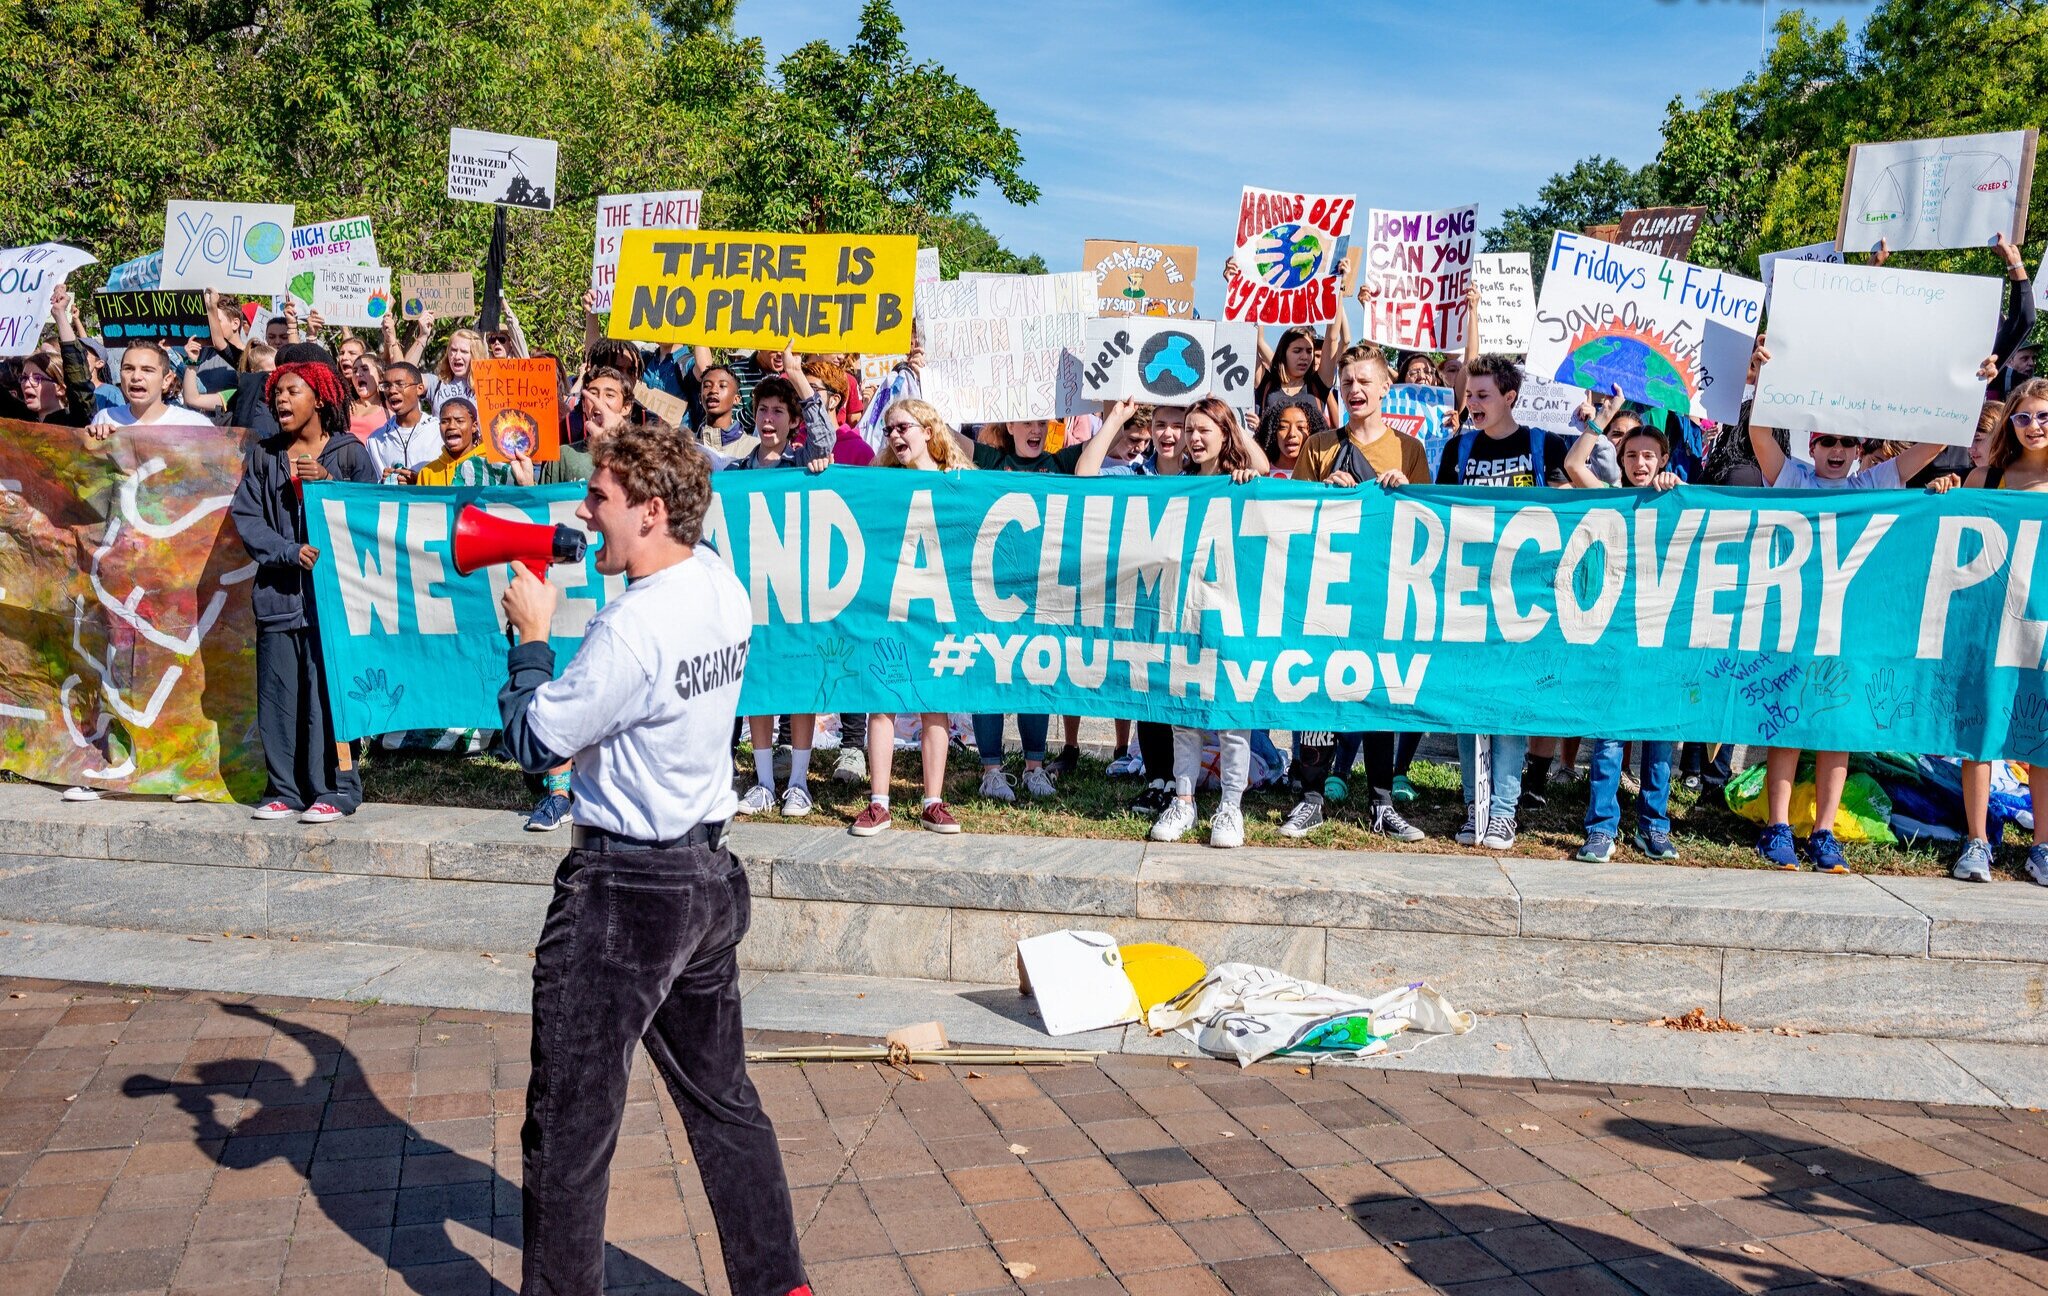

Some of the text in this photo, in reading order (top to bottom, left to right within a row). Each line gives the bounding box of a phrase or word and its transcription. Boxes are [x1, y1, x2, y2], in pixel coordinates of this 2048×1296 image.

[450, 165, 496, 179] CLIMATE
[451, 154, 507, 169] WAR-SIZED
[450, 175, 489, 188] ACTION
[450, 185, 477, 197] NOW!
[1977, 183, 2001, 192] GREED
[603, 199, 699, 228] THE EARTH
[1236, 191, 1355, 249] HANDS OFF
[1866, 213, 1889, 222] Earth
[290, 220, 372, 250] HICH GREEN
[1373, 209, 1475, 243] HOW LONG
[1631, 213, 1697, 239] CLIMATE
[18, 248, 58, 264] NOT
[292, 240, 351, 261] DO YOU SEE?
[600, 237, 615, 255] IS
[1369, 242, 1424, 273] CAN
[595, 264, 616, 287] TH
[654, 242, 876, 286] THERE IS
[1096, 246, 1185, 285] SPEAK FOR THE
[1117, 257, 1155, 272] TREES
[1473, 258, 1530, 276] The Lorax
[319, 268, 385, 285] THIS IS NOT WHAT
[402, 274, 451, 288] I'D BE IN
[1367, 268, 1472, 302] STAND THE
[1551, 232, 1758, 325] Fridays 4 Future
[1793, 265, 1946, 304] Climate Change
[351, 286, 367, 294] WHEN
[416, 287, 470, 299] SCHOOL IF THE
[595, 289, 615, 309] DA
[915, 272, 1097, 320] HOW CAN WE
[1225, 270, 1337, 324] MY FUTURE
[1479, 295, 1522, 308] he Trees
[95, 292, 208, 318] THIS IS NOT COOL
[424, 300, 468, 313] WAS COOL
[628, 285, 903, 338] NO PLANET B
[1113, 297, 1137, 313] SAID
[1140, 297, 1178, 316] FK
[1178, 300, 1191, 314] U
[1370, 298, 1469, 350] HEAT?
[1496, 314, 1511, 325] The
[1479, 335, 1503, 345] Trees
[1536, 300, 1714, 391] Save Our Future
[474, 361, 493, 374] My
[499, 360, 535, 371] World's
[926, 356, 976, 391] THE
[990, 346, 1085, 387] PLANE
[476, 378, 515, 396] FIRE
[1762, 384, 1805, 406] Soon
[1808, 389, 1825, 406] It
[1830, 394, 1845, 406] will
[1844, 398, 1867, 411] just
[1871, 400, 1881, 411] be
[1886, 402, 1897, 412] the
[1934, 407, 1971, 425] Iceberg
[1466, 454, 1533, 477] GREEN
[322, 498, 459, 637] WE
[485, 489, 866, 637] EAND
[887, 489, 957, 624] A
[971, 491, 1363, 639] CLIMATE
[1382, 497, 1900, 658] RECOVERY
[1915, 514, 2048, 674] PL
[674, 636, 752, 701] ORGANIZ
[1705, 656, 1737, 679] We
[1729, 652, 1774, 681] Want
[1763, 700, 1784, 718] by
[1757, 705, 1800, 741] 2100
